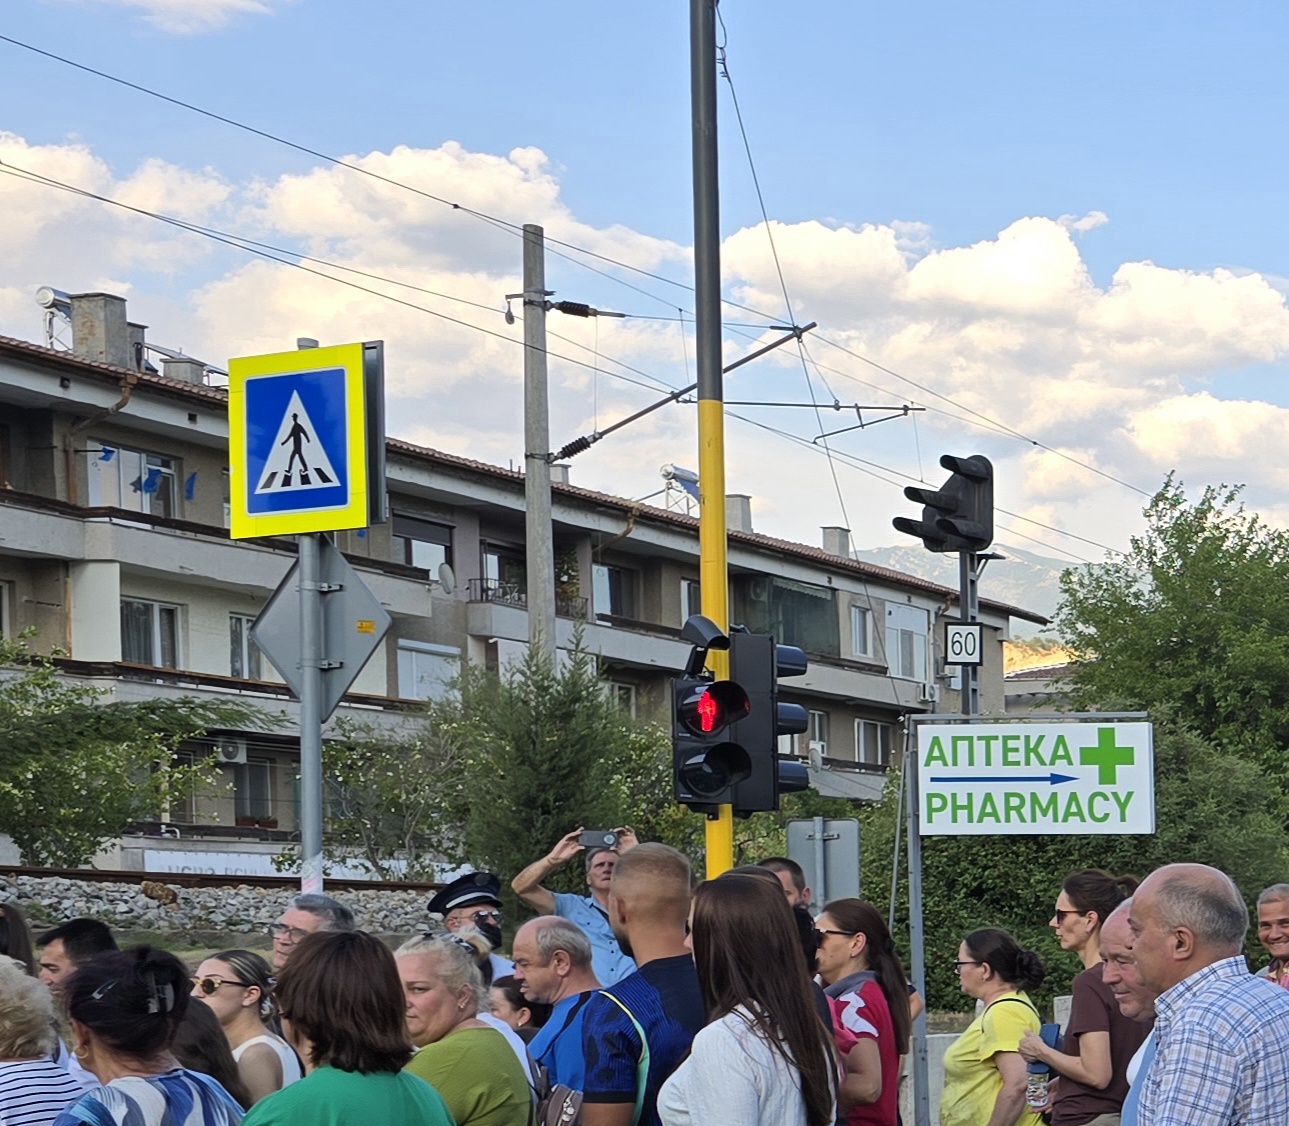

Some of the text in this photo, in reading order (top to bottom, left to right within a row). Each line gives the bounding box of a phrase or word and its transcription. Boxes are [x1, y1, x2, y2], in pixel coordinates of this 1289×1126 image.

[951, 631, 976, 656] 60
[924, 734, 1074, 767] АПТЕКА
[926, 791, 1135, 824] PHARMACY
